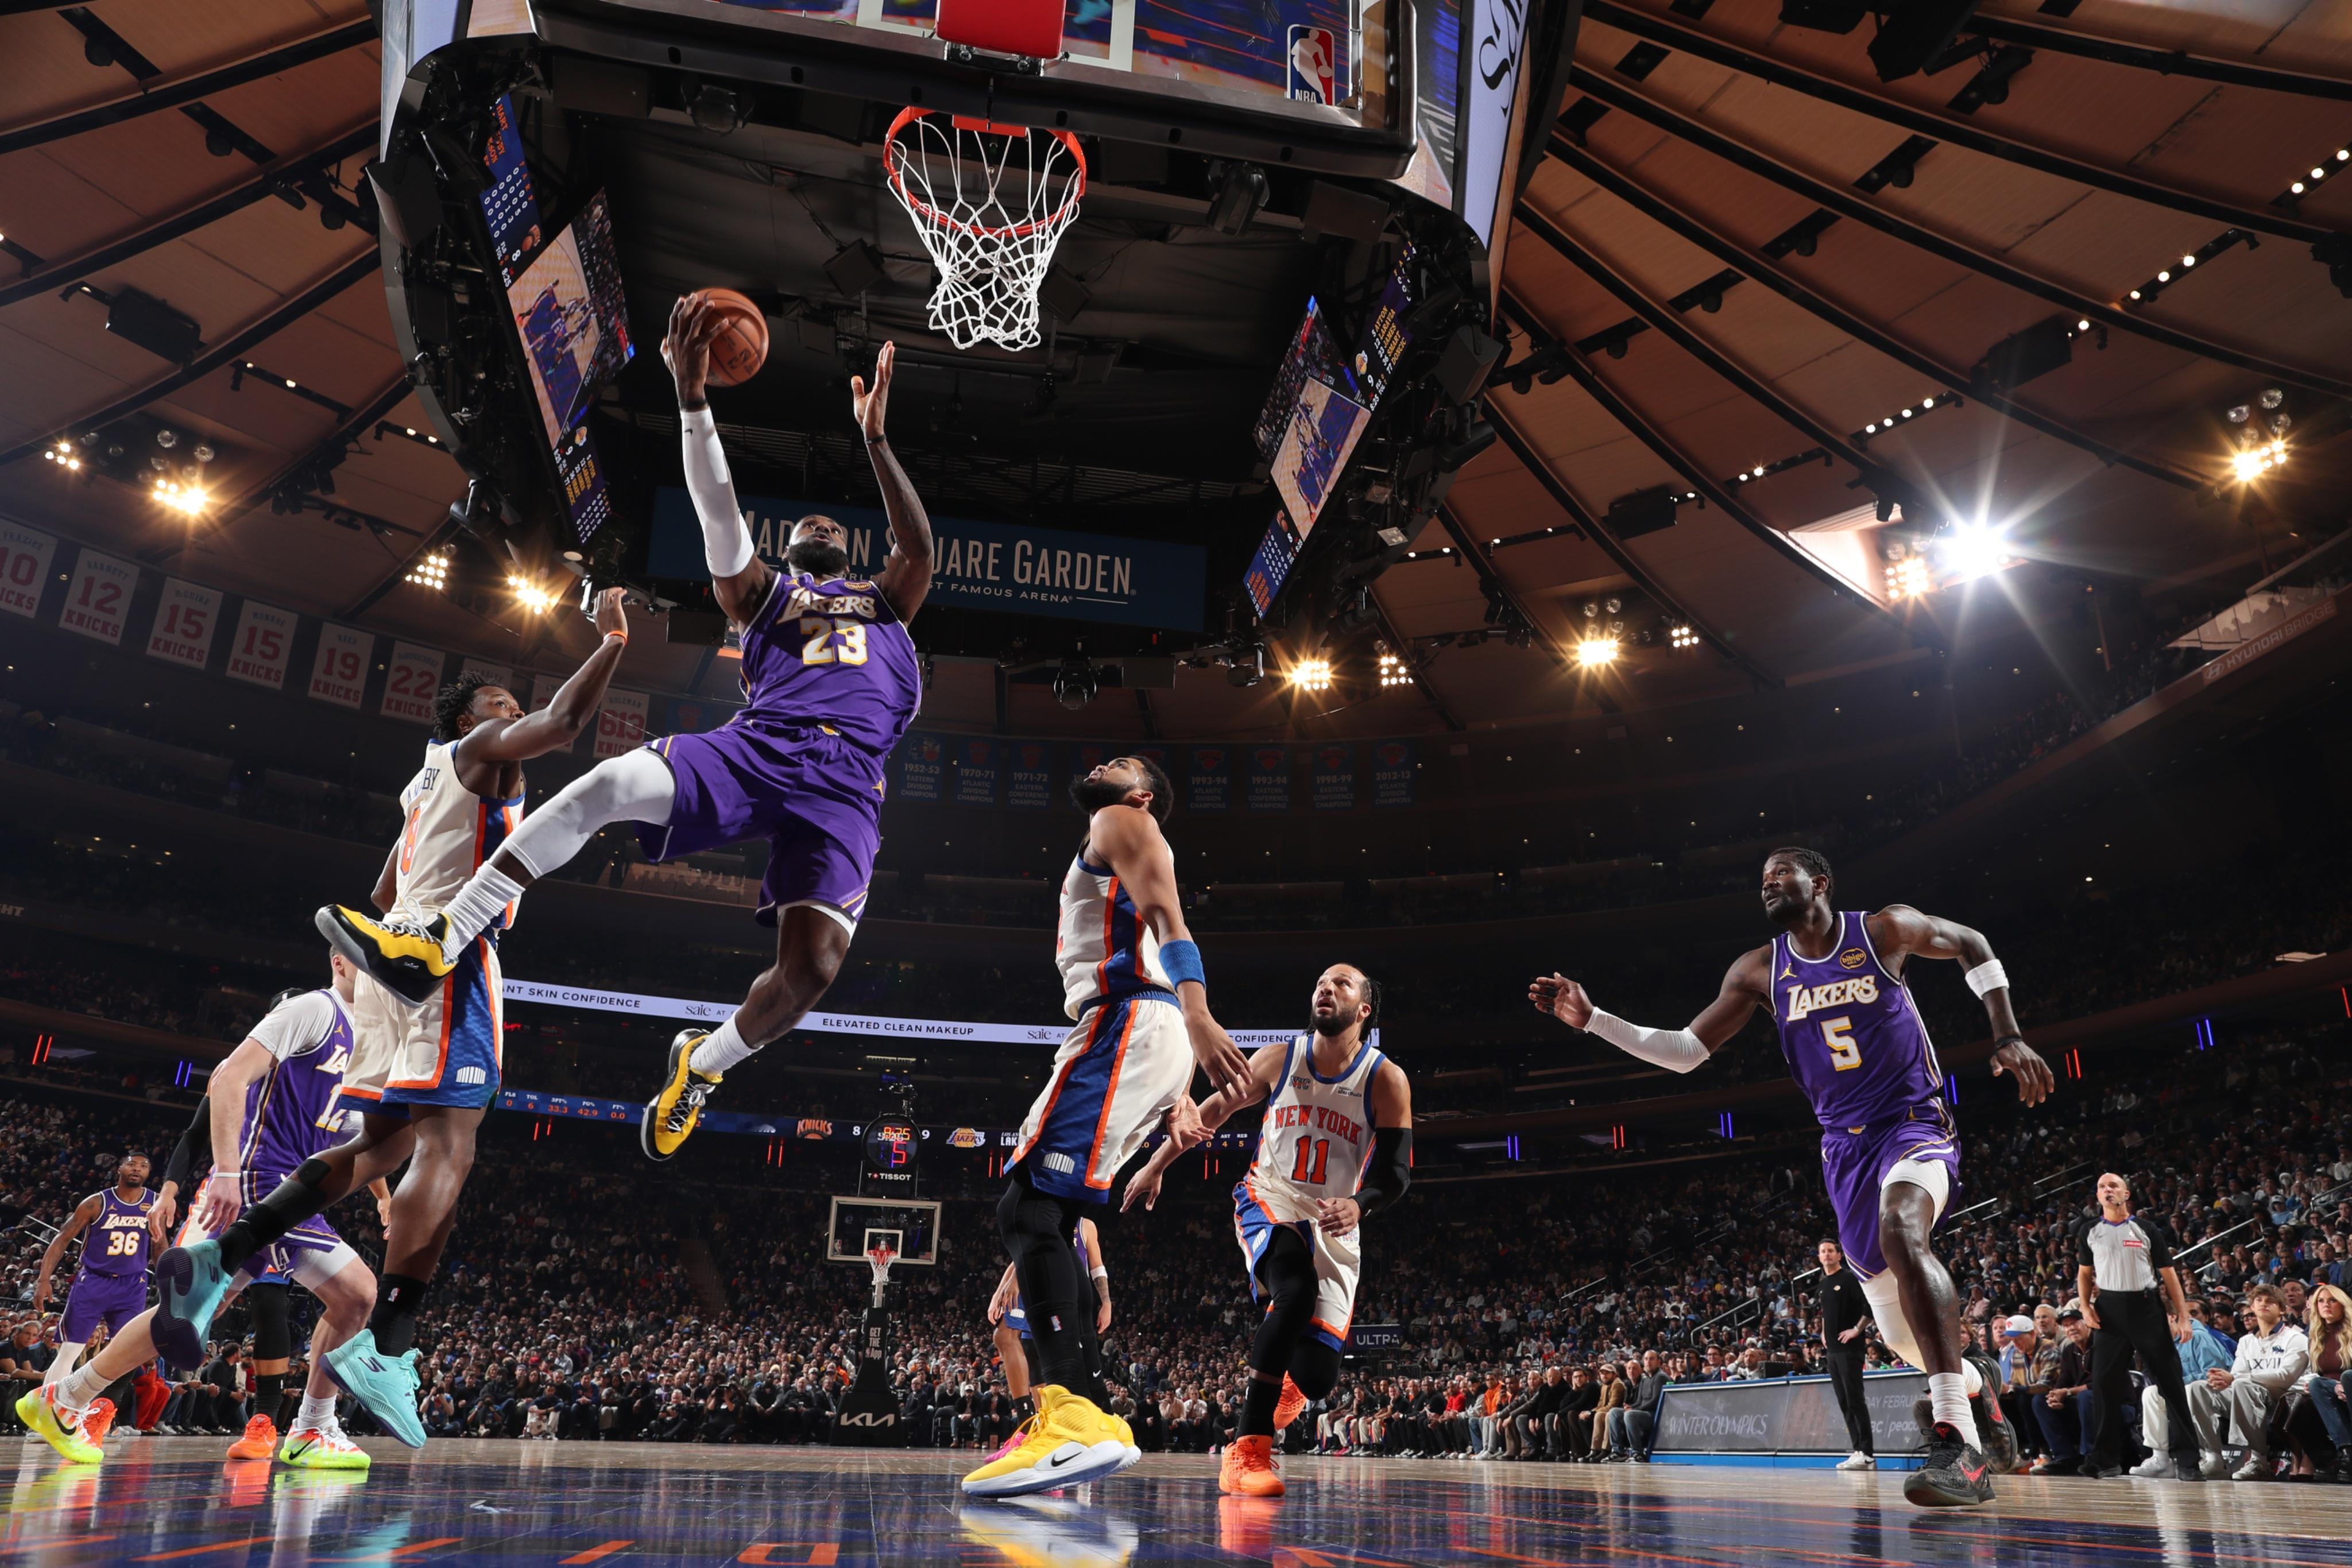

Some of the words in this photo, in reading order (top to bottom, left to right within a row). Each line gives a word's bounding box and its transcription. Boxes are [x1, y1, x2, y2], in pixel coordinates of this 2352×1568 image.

[1295, 88, 1317, 103] NBA
[496, 103, 509, 131] HART
[512, 249, 521, 262] 8
[501, 267, 512, 288] 8:25
[1386, 362, 1393, 375] 77
[1367, 374, 1374, 387] 9
[566, 446, 574, 456] 9
[3, 531, 44, 551] FRAZIER
[0, 547, 38, 586] 10
[87, 560, 129, 580] BARNETT
[1013, 540, 1131, 595] GARDEN
[0, 586, 36, 611] ICKS
[78, 576, 122, 615] 12
[950, 583, 1012, 597] FAMOUS
[1020, 591, 1069, 603] ARENA
[775, 587, 877, 625] LAKERS
[64, 609, 120, 638] KNICKS
[164, 605, 207, 640] 15
[253, 611, 287, 627] MONROE
[243, 626, 284, 661] 15
[799, 617, 868, 666] 23
[2226, 629, 2284, 668] HYUNDAI
[2285, 602, 2335, 636] BRIDGE
[151, 636, 206, 663] KNICKS
[231, 658, 281, 683] KNICKS
[323, 648, 360, 682] 19
[312, 679, 360, 703] KNICKS
[390, 665, 435, 700] 22
[385, 696, 431, 718] KNICKS
[609, 696, 642, 709] HOLZMAN
[598, 710, 645, 741] 613
[904, 762, 941, 775] 1952-53
[960, 768, 996, 779] 1970-71
[1012, 772, 1049, 782] 1971-72
[1375, 770, 1411, 781] 2012-13
[906, 775, 935, 784] EASTERN
[907, 783, 934, 791] DIVISION
[962, 780, 992, 788] ATLANTIC
[1015, 783, 1044, 791] EASTERN
[1316, 774, 1353, 784] 1998-99
[900, 789, 938, 799] CHAMPIONS
[957, 794, 993, 803] CHAMPIONS
[962, 787, 989, 795] DIVISION
[1008, 791, 1050, 799] CONFERENCE
[1010, 798, 1047, 807] CHAMPIONS
[1251, 802, 1287, 810] CHAMPIONS
[1316, 801, 1352, 809] CHAMPIONS
[1375, 797, 1413, 806] CHAMPIONS
[1842, 953, 1864, 963] bibigo
[1786, 974, 1879, 1023] LAKERS
[528, 988, 558, 998] SKIN
[562, 992, 641, 1008] CONFIDENCE
[685, 1004, 711, 1017] saie
[822, 1018, 880, 1030] ELEVATED
[884, 1023, 922, 1032] CLEAN
[925, 1025, 974, 1036] MAKEUP
[1027, 1028, 1052, 1040] saie
[1231, 1035, 1298, 1043] CONFIDENCE
[1820, 1015, 1863, 1072] 5
[1289, 1075, 1311, 1090] NYC
[527, 1102, 534, 1110] 6
[548, 1104, 568, 1114] 33.3
[577, 1108, 598, 1117] 42.9
[610, 1112, 625, 1120] 0.0
[796, 1119, 833, 1135] KNICKS
[852, 1125, 861, 1136] 8
[921, 1129, 931, 1140] 9
[1275, 1105, 1313, 1130] NEW
[1316, 1106, 1363, 1146] YORK
[1000, 1137, 1018, 1146] LAK
[892, 1140, 907, 1164] 5
[1291, 1135, 1330, 1186] 11
[879, 1172, 912, 1181] TISSOT
[100, 1213, 148, 1229] LAKERS
[106, 1231, 140, 1256] 36
[869, 1327, 881, 1337] GET
[1356, 1334, 1400, 1346] ULTRA
[869, 1337, 880, 1347] THE
[840, 1412, 895, 1428] KIA
[1670, 1414, 1709, 1435] WINTER
[1709, 1412, 1769, 1435] OLYMPICS
[1887, 1420, 1919, 1438] peaco
